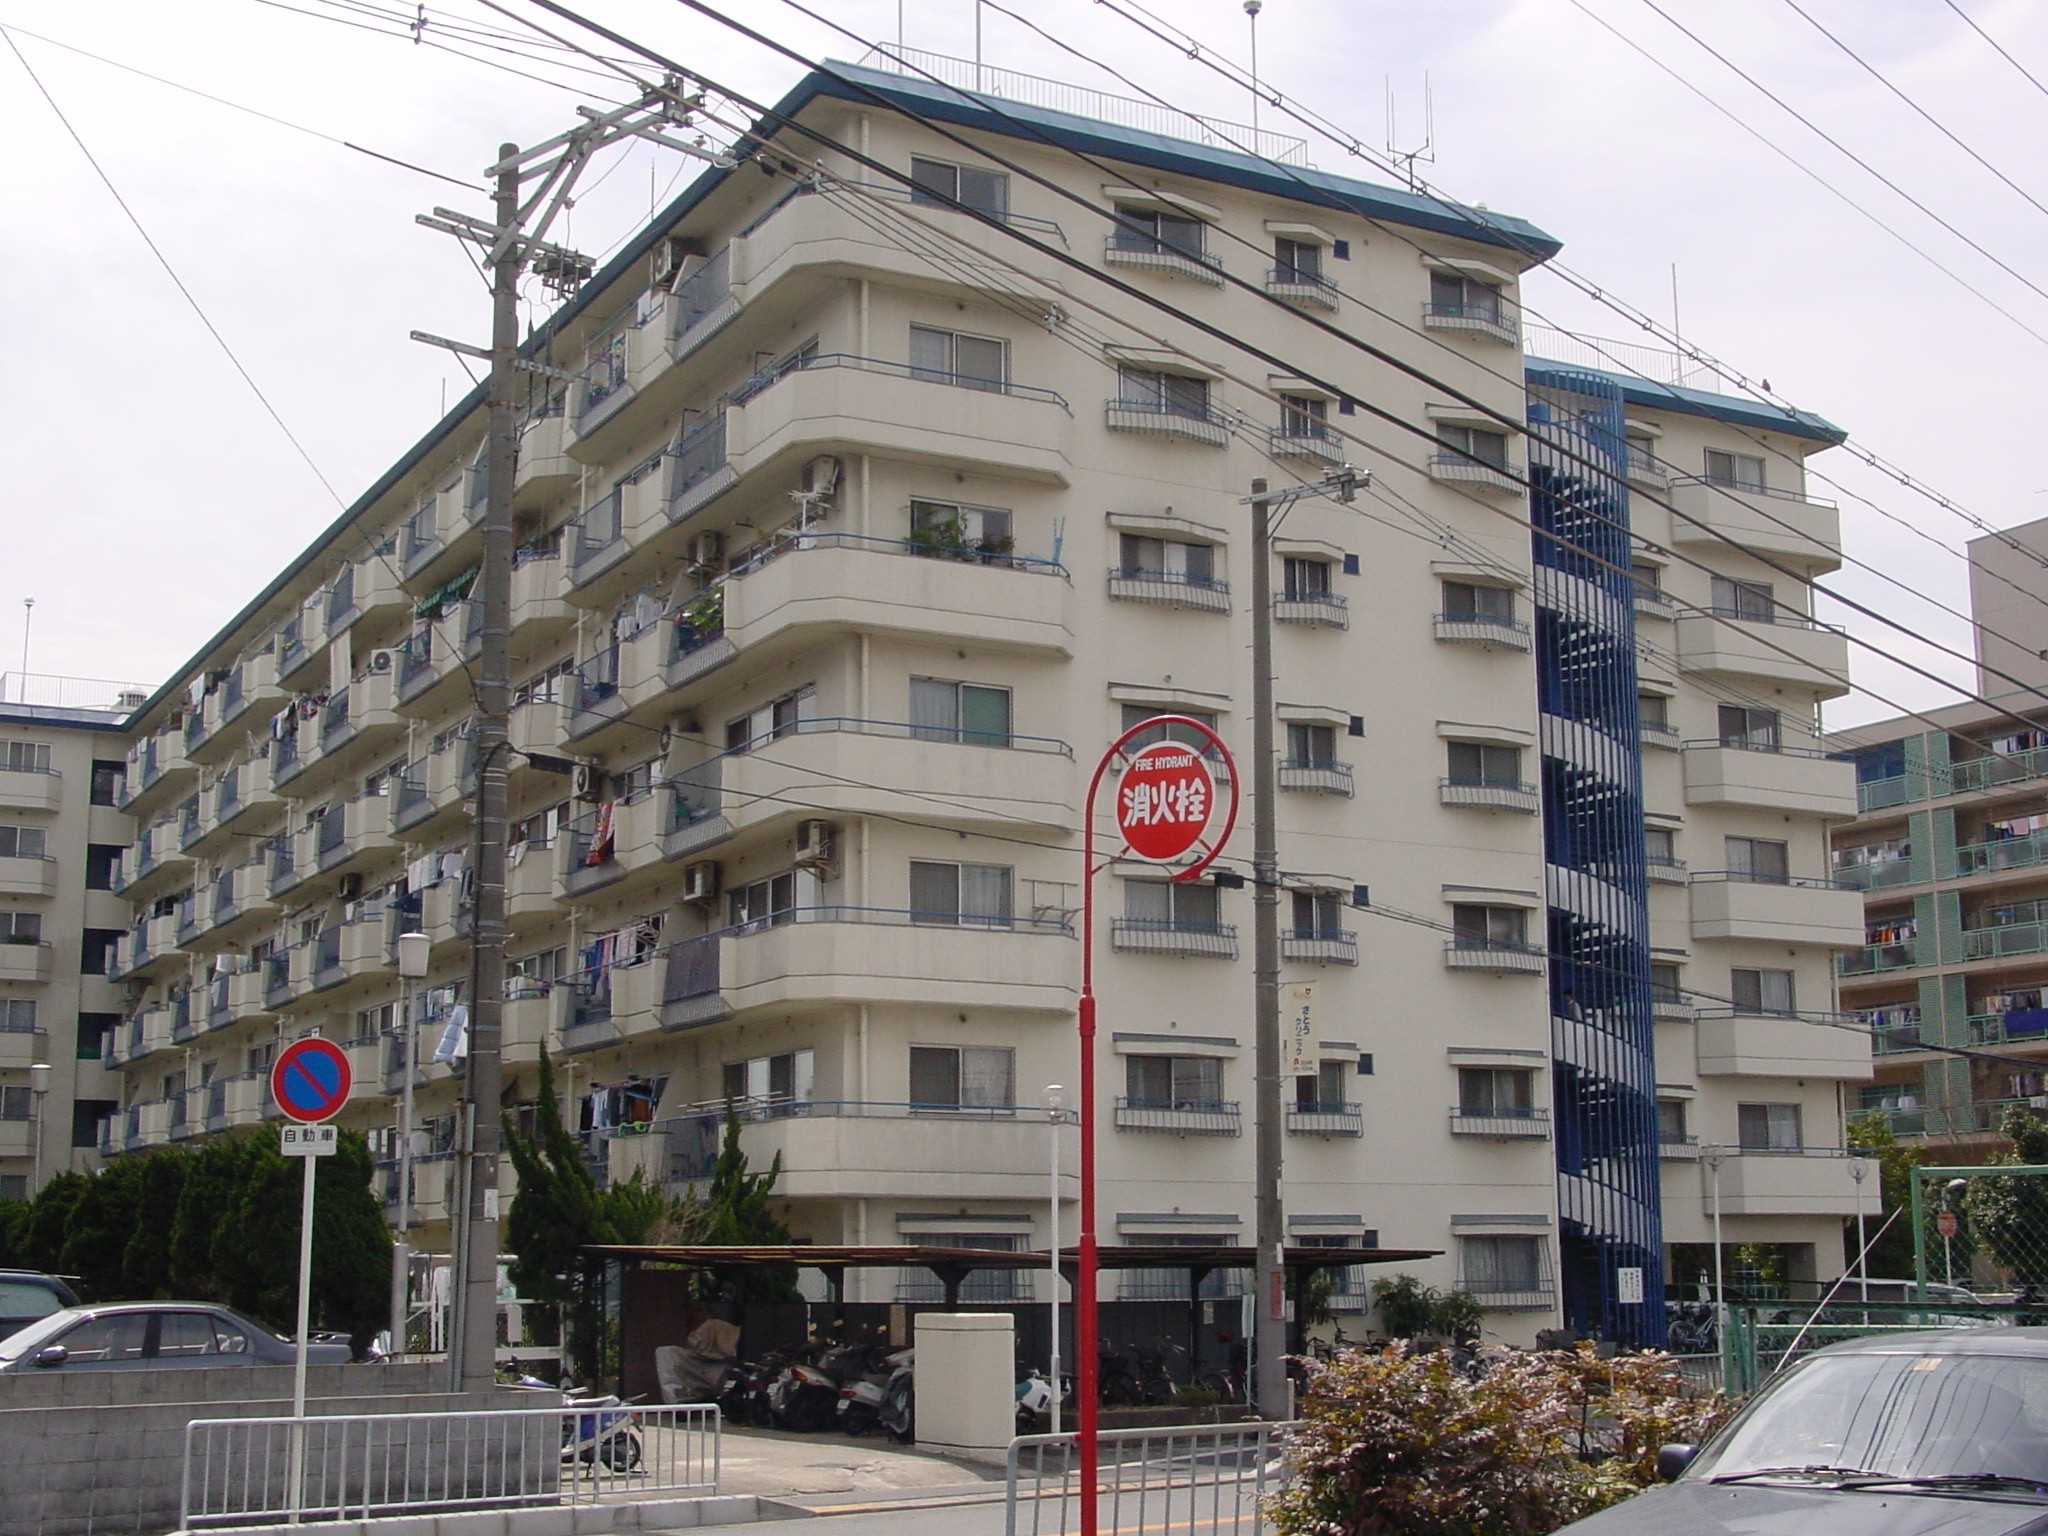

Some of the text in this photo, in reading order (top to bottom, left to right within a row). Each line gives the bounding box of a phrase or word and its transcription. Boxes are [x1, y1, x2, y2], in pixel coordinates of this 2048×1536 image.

[1135, 755, 1193, 771] FIRE HYDRANT
[1123, 777, 1206, 827] 消火栓
[285, 1128, 334, 1142] 自動車
